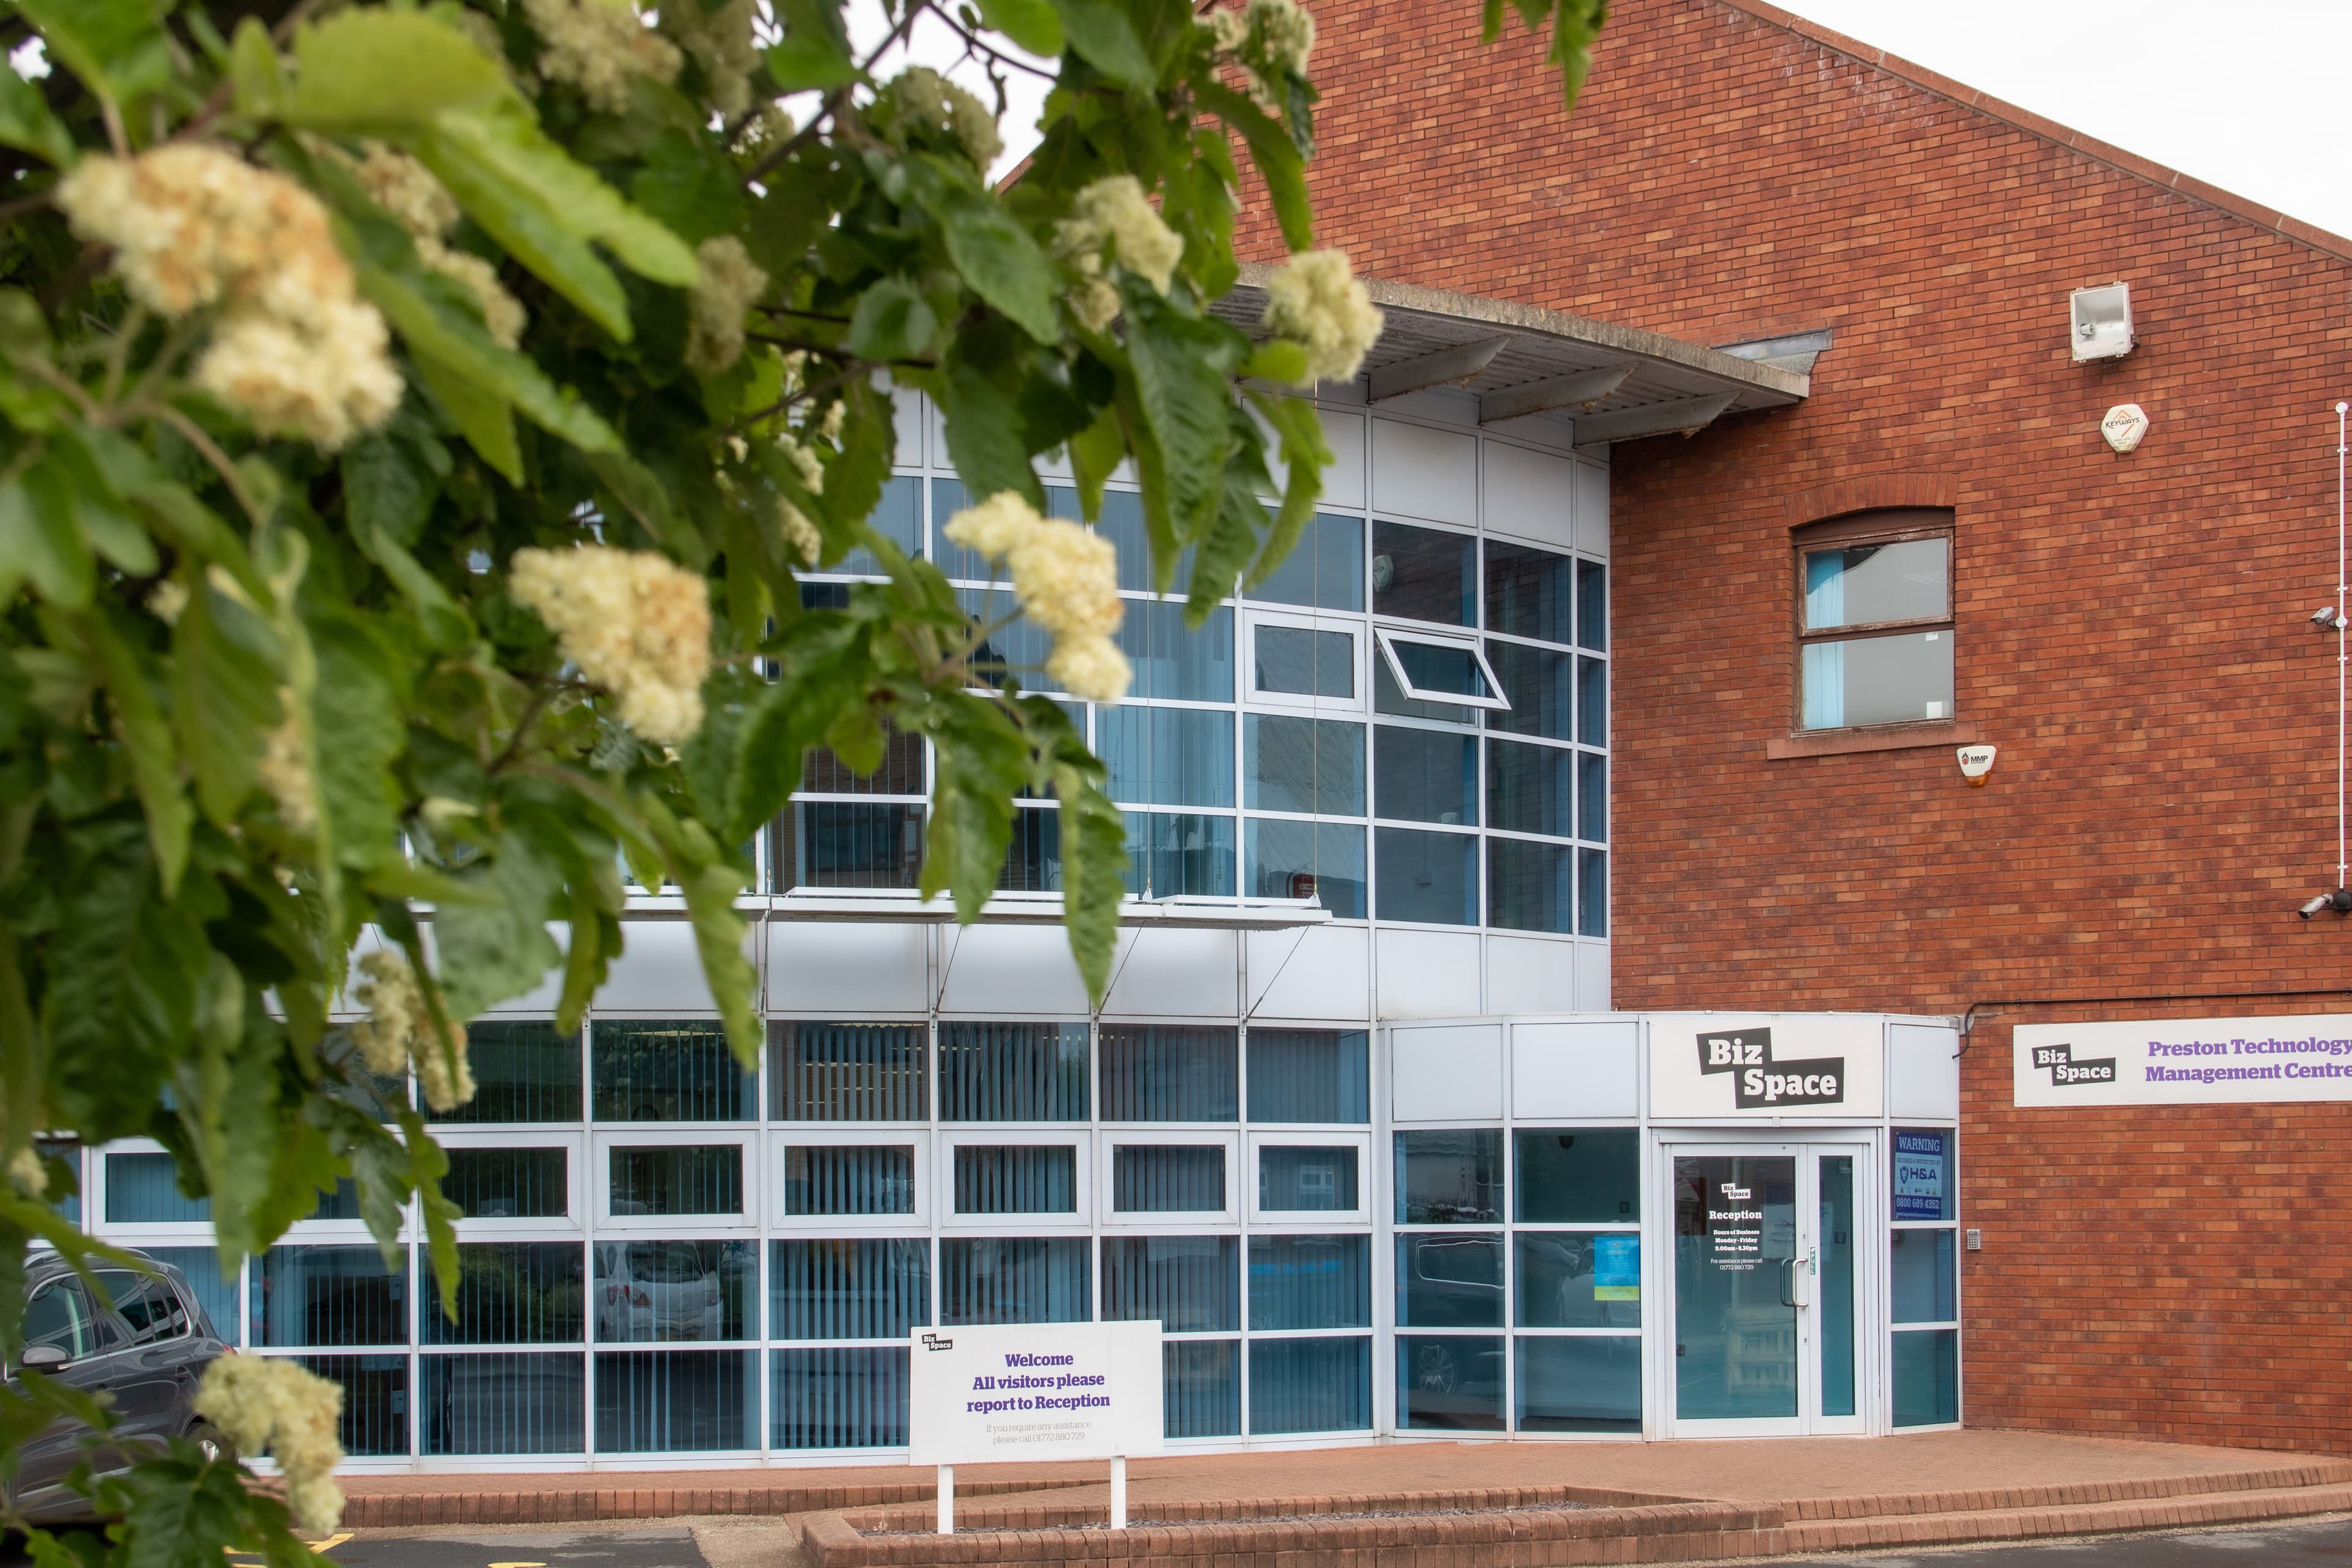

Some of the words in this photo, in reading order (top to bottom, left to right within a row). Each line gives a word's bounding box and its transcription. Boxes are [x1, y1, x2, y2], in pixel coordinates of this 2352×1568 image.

[2105, 417, 2140, 429] KEYWAYS
[1708, 1038, 1763, 1065] Biz
[2148, 1041, 2228, 1057] Preston
[2231, 1037, 2352, 1055] Technology
[2038, 1050, 2067, 1064] Biz
[2056, 1065, 2111, 1081] Space
[2145, 1064, 2282, 1084] Management
[2284, 1063, 2352, 1079] Centre
[1744, 1069, 1837, 1101] Space
[1898, 1137, 1940, 1152] WARNING
[1910, 1167, 1937, 1180] H&A
[1896, 1197, 1911, 1207] 0800
[1912, 1198, 1923, 1208] 689
[1924, 1199, 1939, 1209] 4352
[1709, 1210, 1762, 1221] Reception
[1005, 1353, 1074, 1367] Welcome
[973, 1376, 995, 1390] All
[997, 1374, 1055, 1389] visitors
[1056, 1373, 1105, 1390] please
[967, 1397, 1016, 1414] report
[1017, 1397, 1033, 1410] to
[1035, 1393, 1110, 1411] Reception
[986, 1424, 992, 1433] If
[1009, 1423, 1037, 1433] require
[1053, 1421, 1091, 1430] assistance
[993, 1436, 1017, 1446] please
[1018, 1434, 1032, 1443] call
[1033, 1433, 1054, 1442] 01772
[1055, 1433, 1071, 1441] 880
[1071, 1431, 1085, 1441] 729
